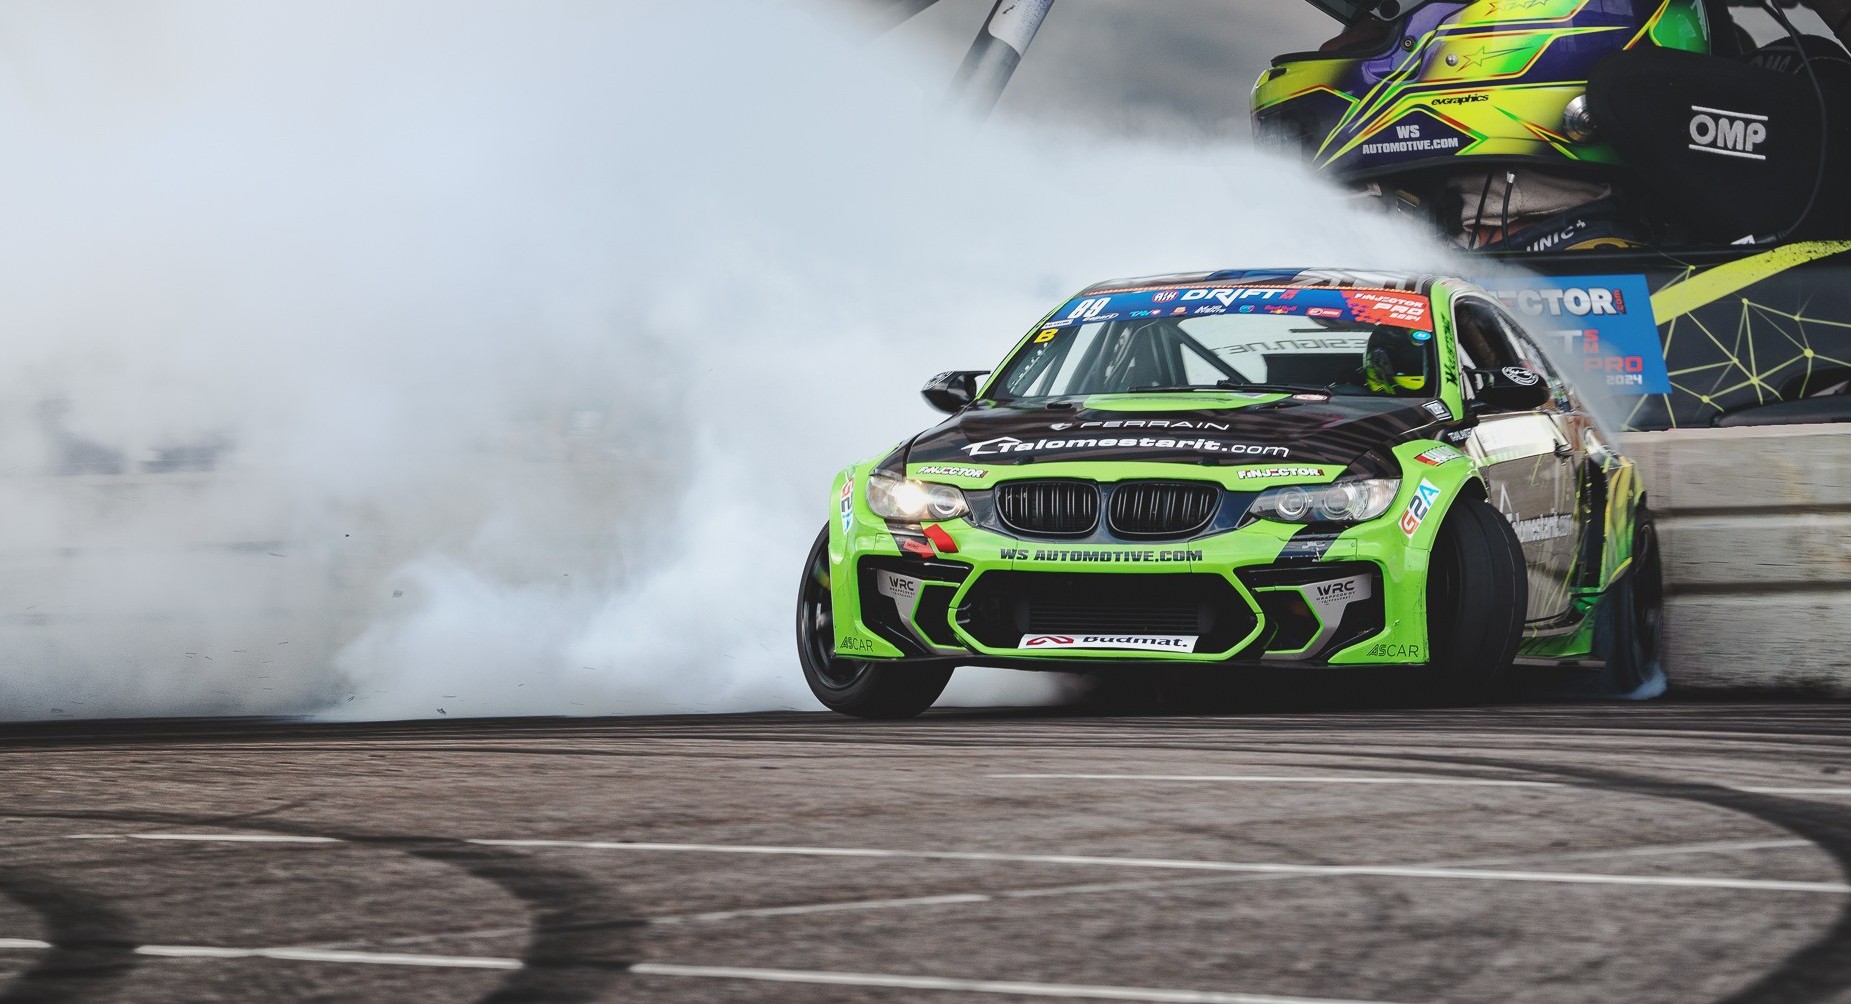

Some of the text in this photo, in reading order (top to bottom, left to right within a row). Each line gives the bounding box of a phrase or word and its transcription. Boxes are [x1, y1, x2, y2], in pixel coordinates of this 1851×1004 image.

[1396, 125, 1420, 139] WS
[1689, 114, 1768, 152] OMP
[1362, 138, 1459, 154] AUTOMOTIVE.COM
[1180, 288, 1286, 307] DRIFT
[1034, 328, 1059, 344] B
[1584, 356, 1643, 373] PRO
[1606, 374, 1643, 386] 2024
[997, 437, 1289, 458] Talomestarit.com
[1401, 482, 1440, 536] G2A
[1000, 548, 1203, 562] WS AUTOMOTIVE.COM
[889, 576, 914, 592] WRC
[1316, 580, 1355, 597] WRC
